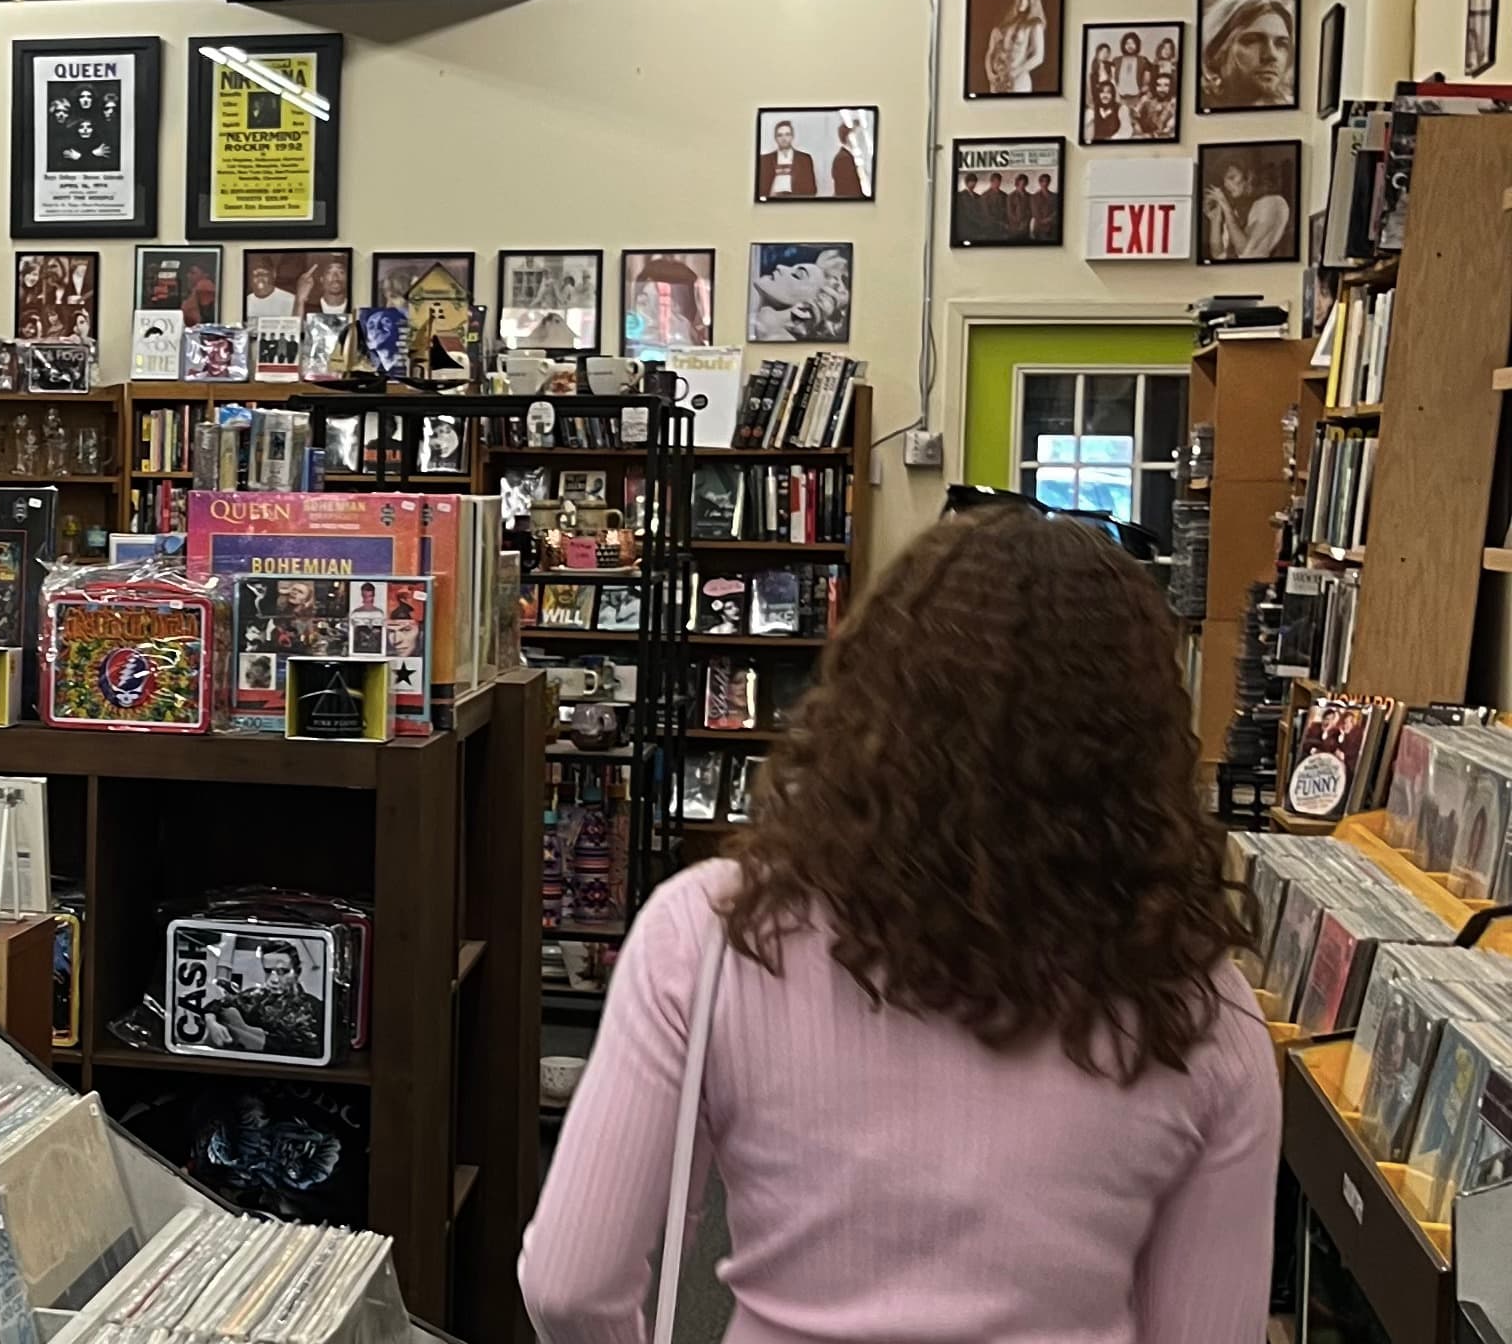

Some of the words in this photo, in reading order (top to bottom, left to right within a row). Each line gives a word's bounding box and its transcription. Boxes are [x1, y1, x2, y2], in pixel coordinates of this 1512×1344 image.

[54, 62, 117, 79] QUEEN
[959, 149, 1010, 168] KINKS
[1105, 204, 1176, 254] EXIT
[210, 499, 291, 524] QUEEN
[302, 499, 366, 512] BOHEMIAN
[251, 557, 353, 576] BOHEMIAN
[543, 607, 584, 625] WILL
[1294, 775, 1341, 796] FUNNY
